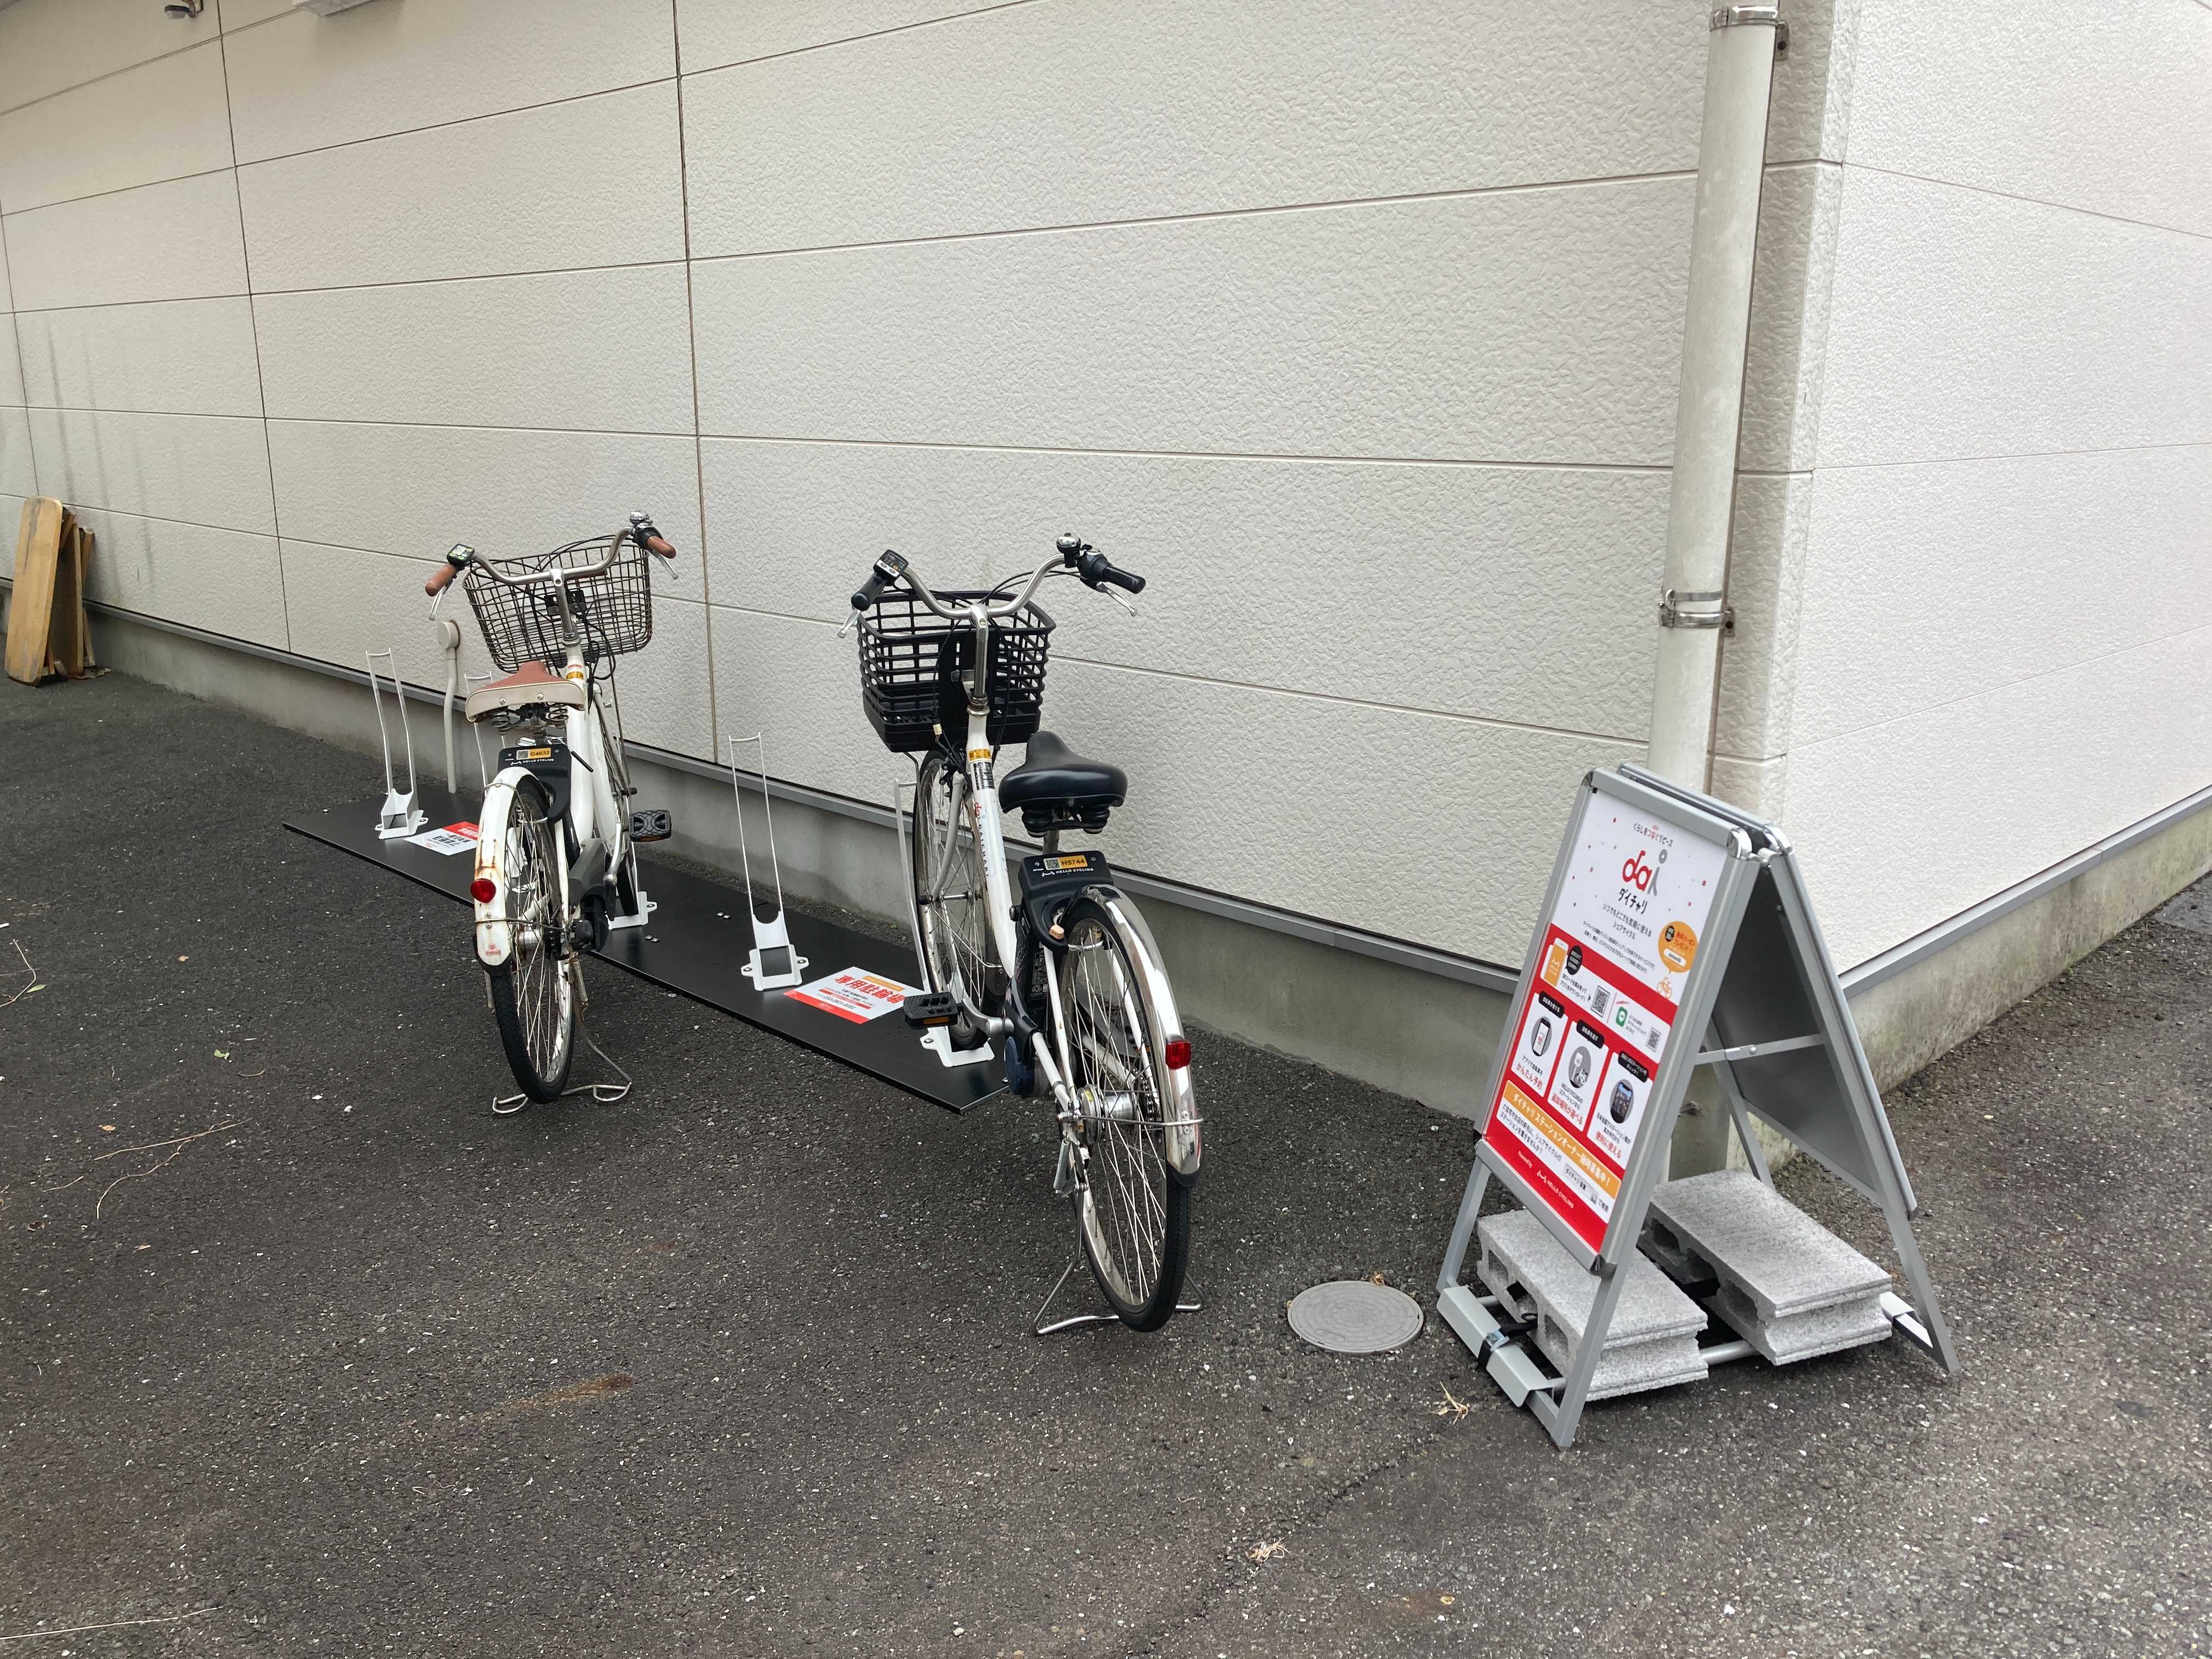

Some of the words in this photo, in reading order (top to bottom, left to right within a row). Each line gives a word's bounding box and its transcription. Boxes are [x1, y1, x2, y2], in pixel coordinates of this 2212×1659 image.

[978, 824, 989, 877] DAICHARI
[1622, 849, 1667, 896] dai
[1618, 888, 1647, 915] ダイチャリ
[1603, 904, 1652, 937] いつでもどこでも気軽に使える
[1612, 922, 1636, 940] シェアサイクル
[834, 975, 906, 1003] 専用駐輪場
[1516, 1062, 1543, 1090] かんたん予約
[1514, 1093, 1534, 1118] ダイチャリ
[1547, 1180, 1559, 1194] HELLO
[1559, 1191, 1574, 1209] CYCLING
